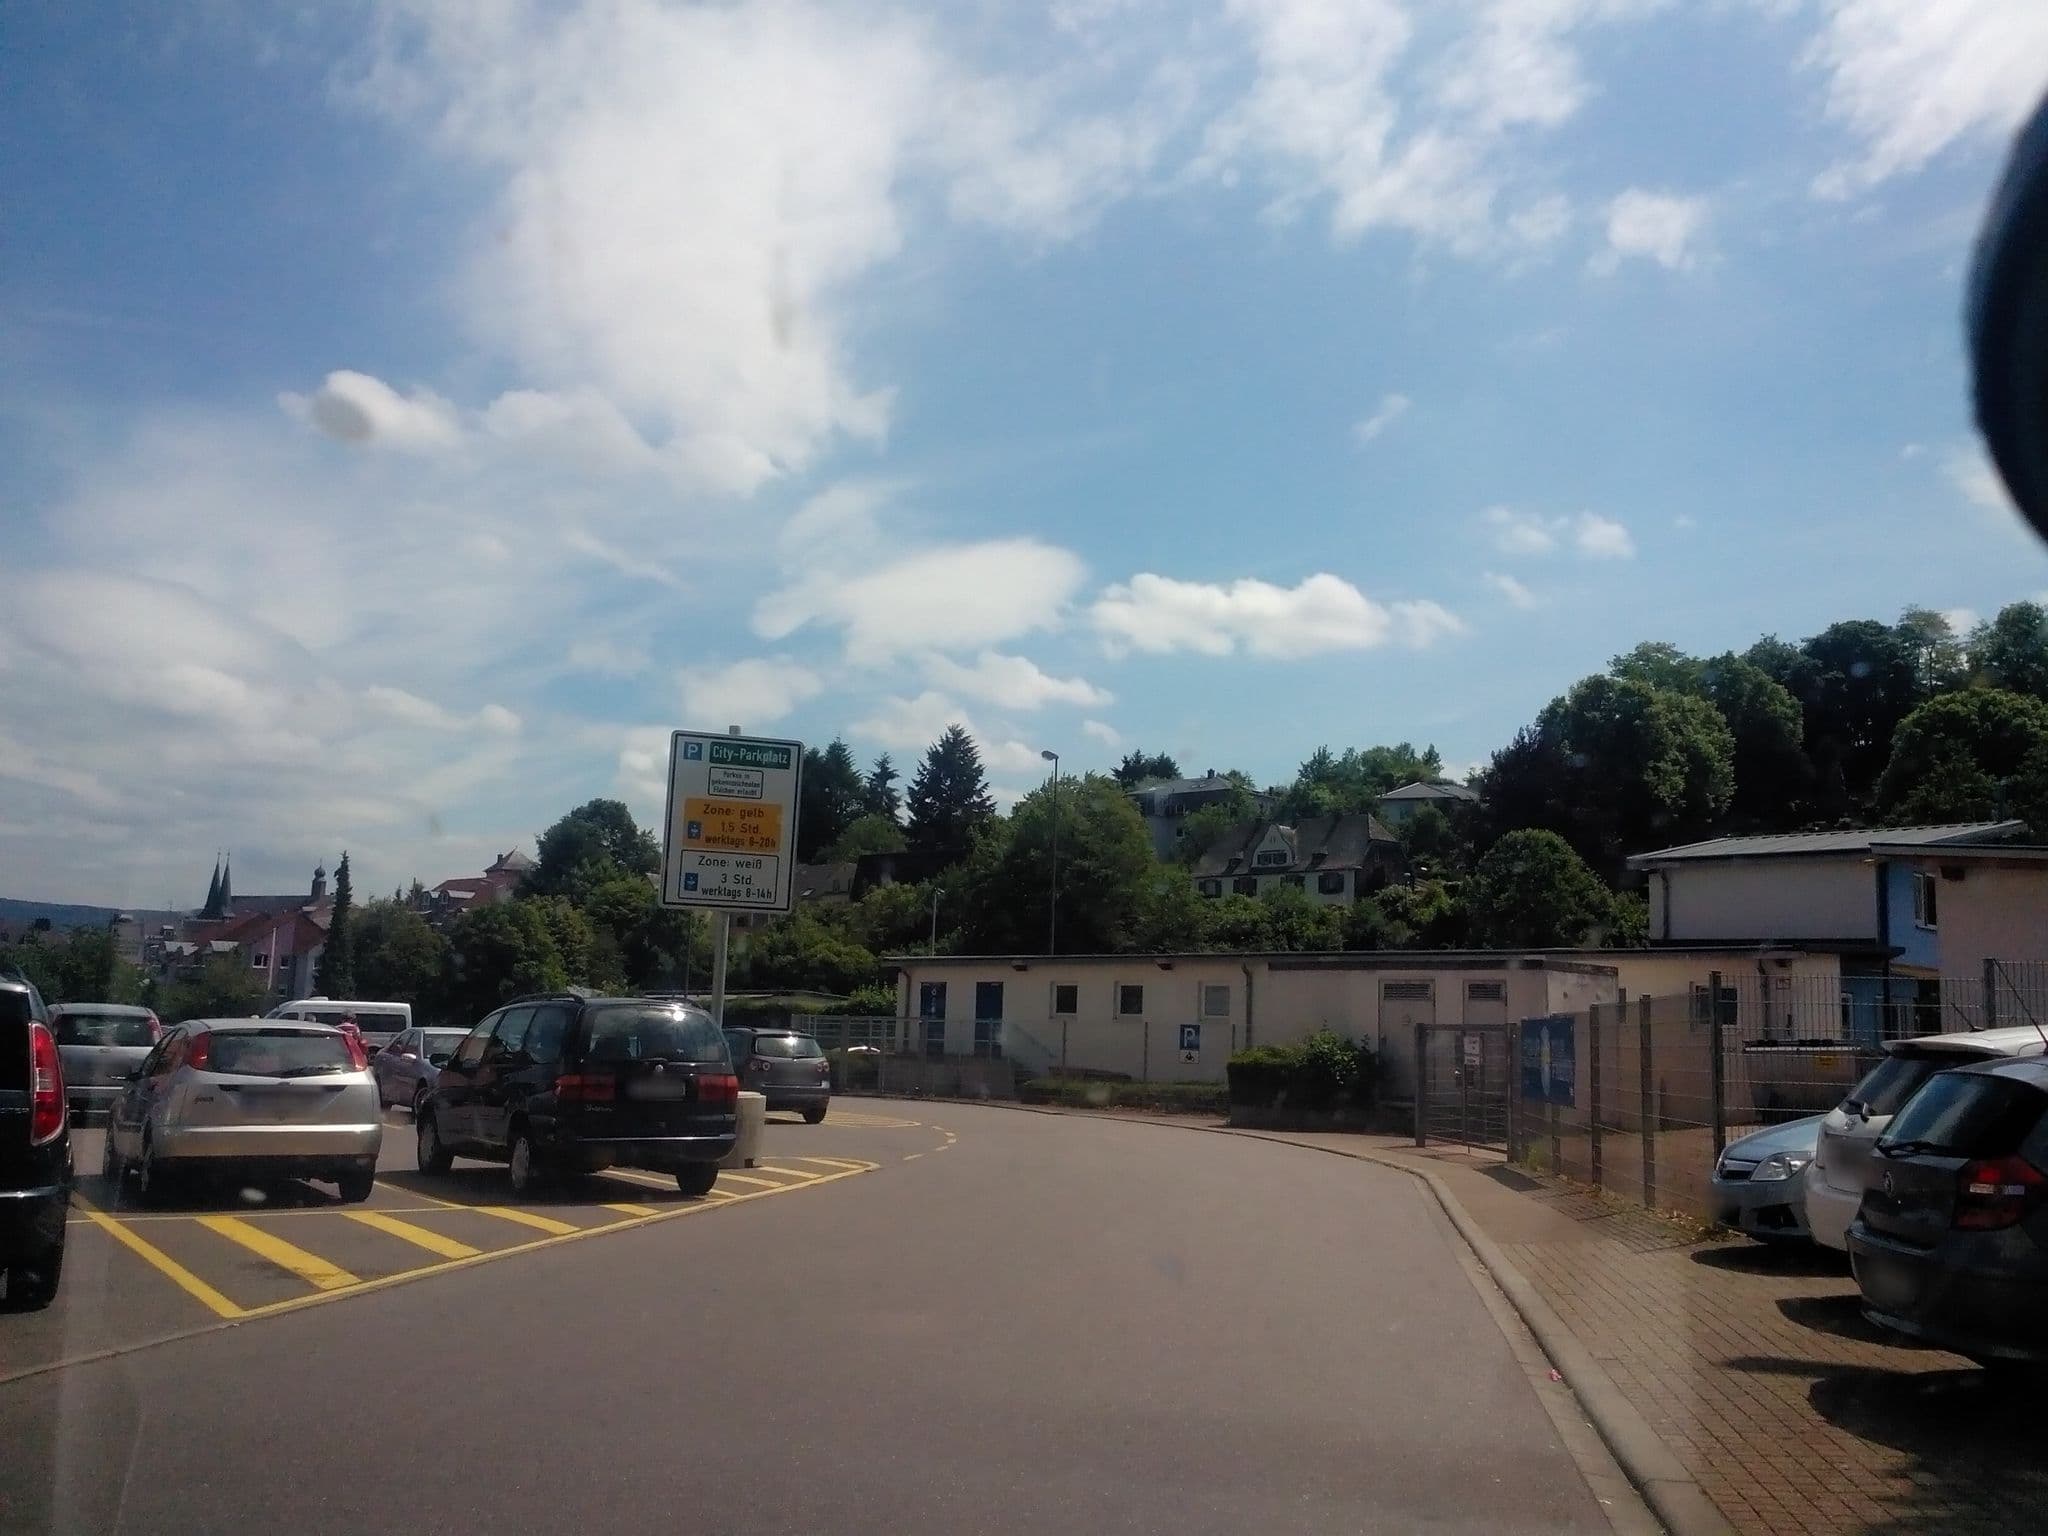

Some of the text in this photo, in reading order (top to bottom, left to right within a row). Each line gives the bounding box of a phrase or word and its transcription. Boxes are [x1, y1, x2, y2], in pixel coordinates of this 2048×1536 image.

[687, 744, 788, 764] P City-Parkplatz
[703, 804, 764, 820] Zone: gelb
[740, 823, 761, 834] Std.
[705, 835, 745, 848] werktags
[698, 856, 762, 869] Zone: weiß
[721, 873, 755, 885] 3 Std.
[702, 886, 742, 899] werktags
